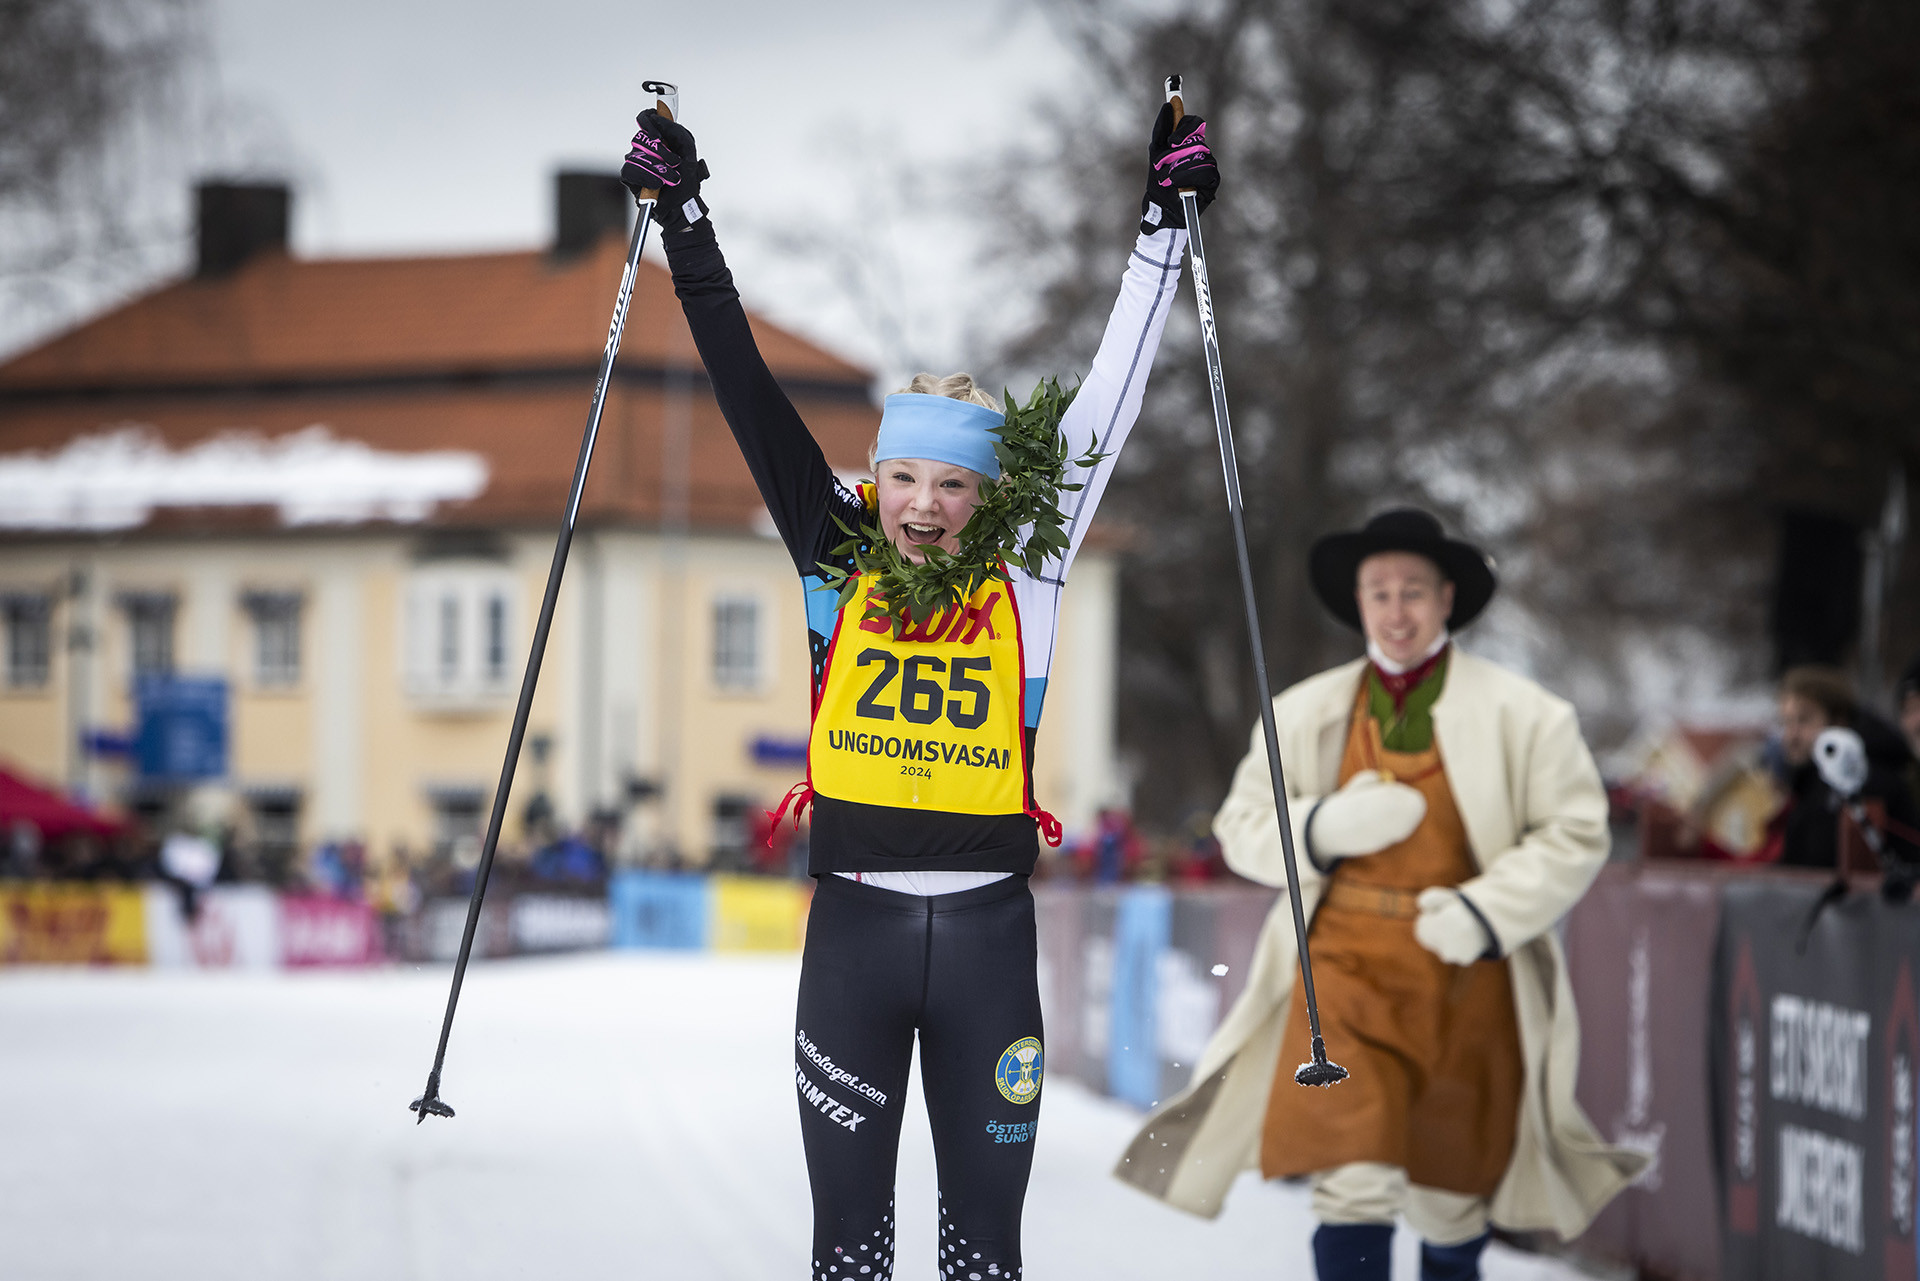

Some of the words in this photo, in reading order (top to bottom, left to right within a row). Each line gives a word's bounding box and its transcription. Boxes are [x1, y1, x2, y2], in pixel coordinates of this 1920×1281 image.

[855, 647, 992, 730] 265
[828, 730, 1011, 770] UNGDOMSVASAN
[900, 765, 932, 780] 2024
[796, 1029, 888, 1105] Bilbolaget.com
[986, 1120, 1028, 1135] ÖSTER
[994, 1133, 1029, 1144] SUND
